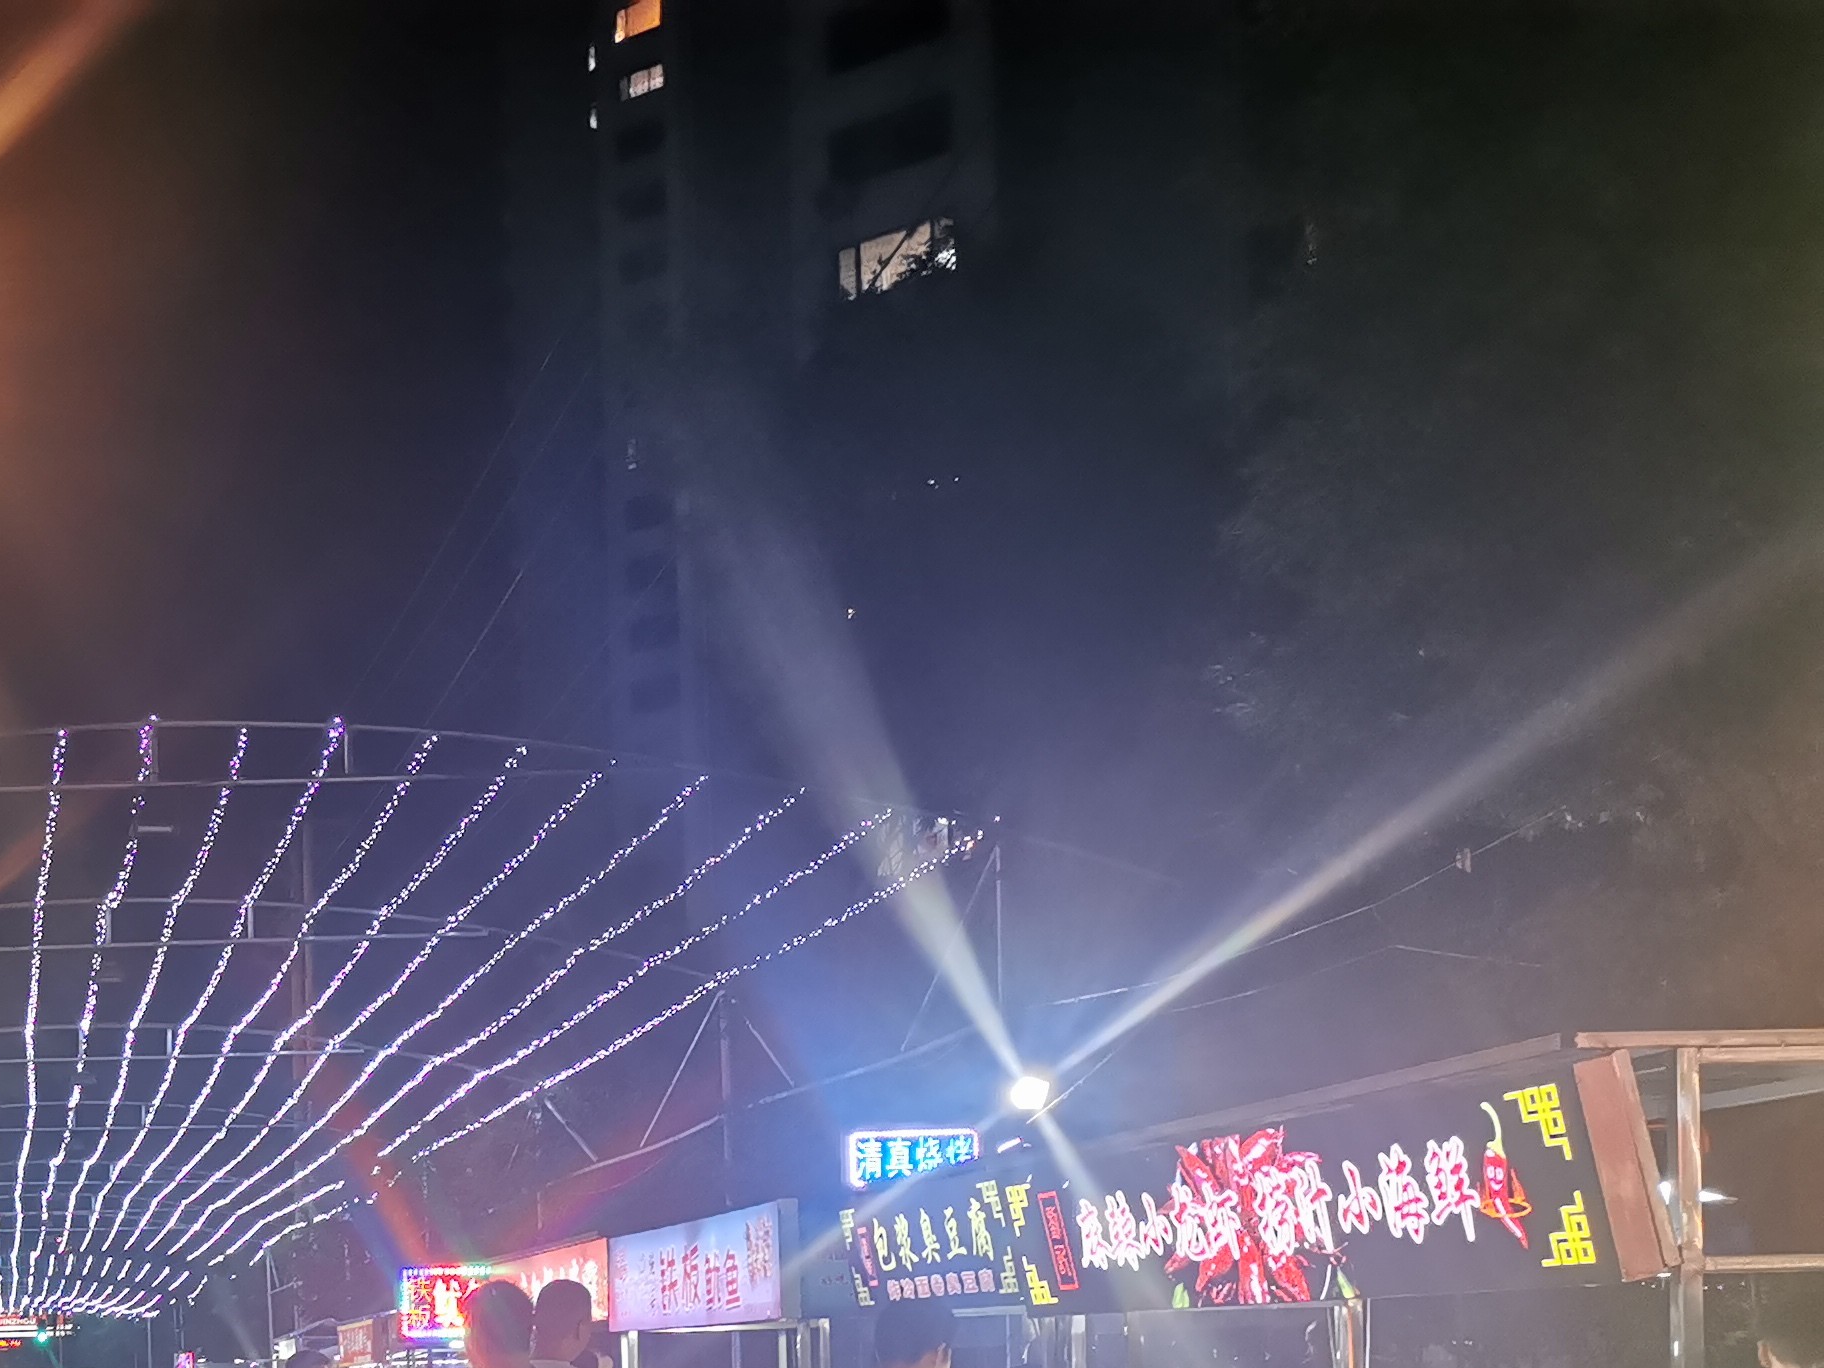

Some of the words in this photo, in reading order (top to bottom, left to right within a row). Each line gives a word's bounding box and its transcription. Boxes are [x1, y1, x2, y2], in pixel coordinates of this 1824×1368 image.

[856, 1134, 973, 1181] 清真烧烤
[873, 1197, 995, 1272] 包浆臭豆腐
[1077, 1187, 1242, 1271] 麻辣小龙虾
[1252, 1135, 1482, 1254] 捞汁小海鲜
[660, 1241, 742, 1313] 铁板鱿鱼
